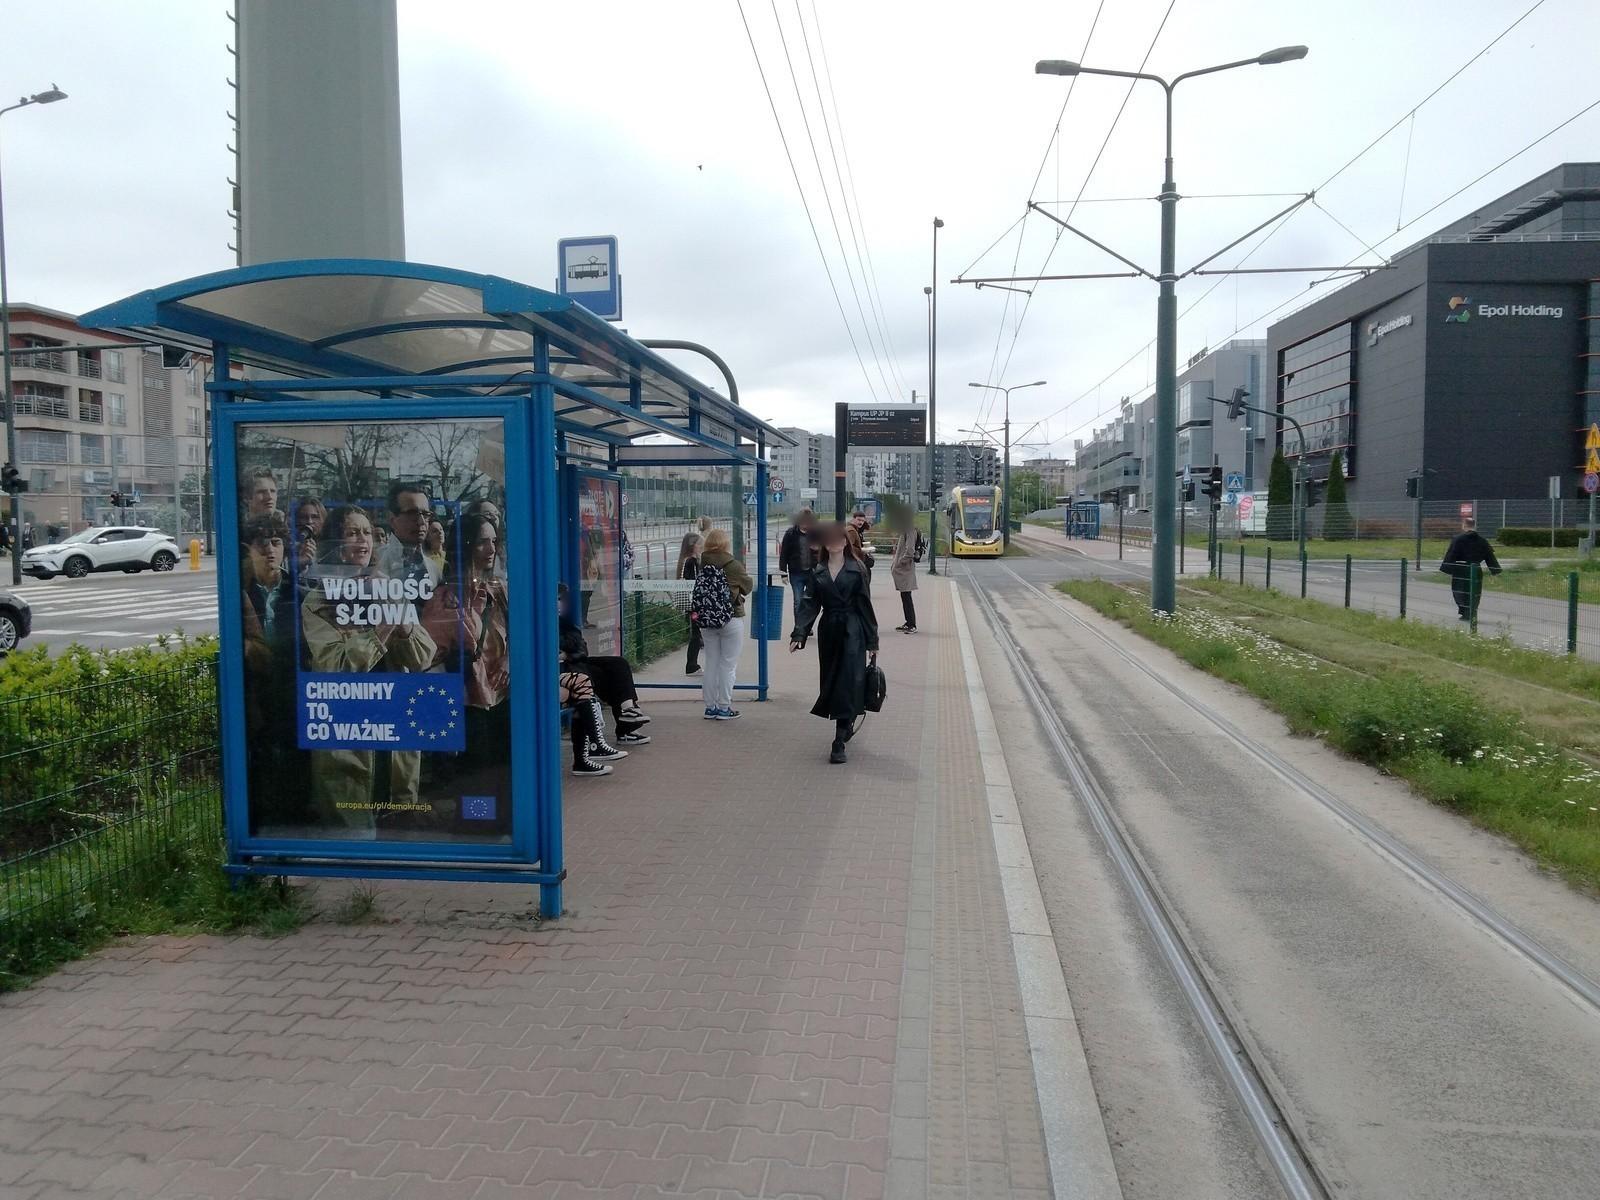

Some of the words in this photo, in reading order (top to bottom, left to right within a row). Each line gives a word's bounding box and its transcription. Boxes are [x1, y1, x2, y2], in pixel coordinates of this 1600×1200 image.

[1478, 304, 1509, 318] Epol
[1511, 304, 1563, 318] Holding
[773, 481, 783, 489] 50
[322, 573, 434, 600] WOLNOŚĆ
[336, 603, 421, 626] SŁOWA
[306, 682, 395, 700] CHRONIMY
[306, 702, 333, 722] TO,
[306, 723, 330, 741] CO
[333, 719, 401, 742] WAŻNE.
[336, 802, 433, 813] europa.eu/pl/demokracja
